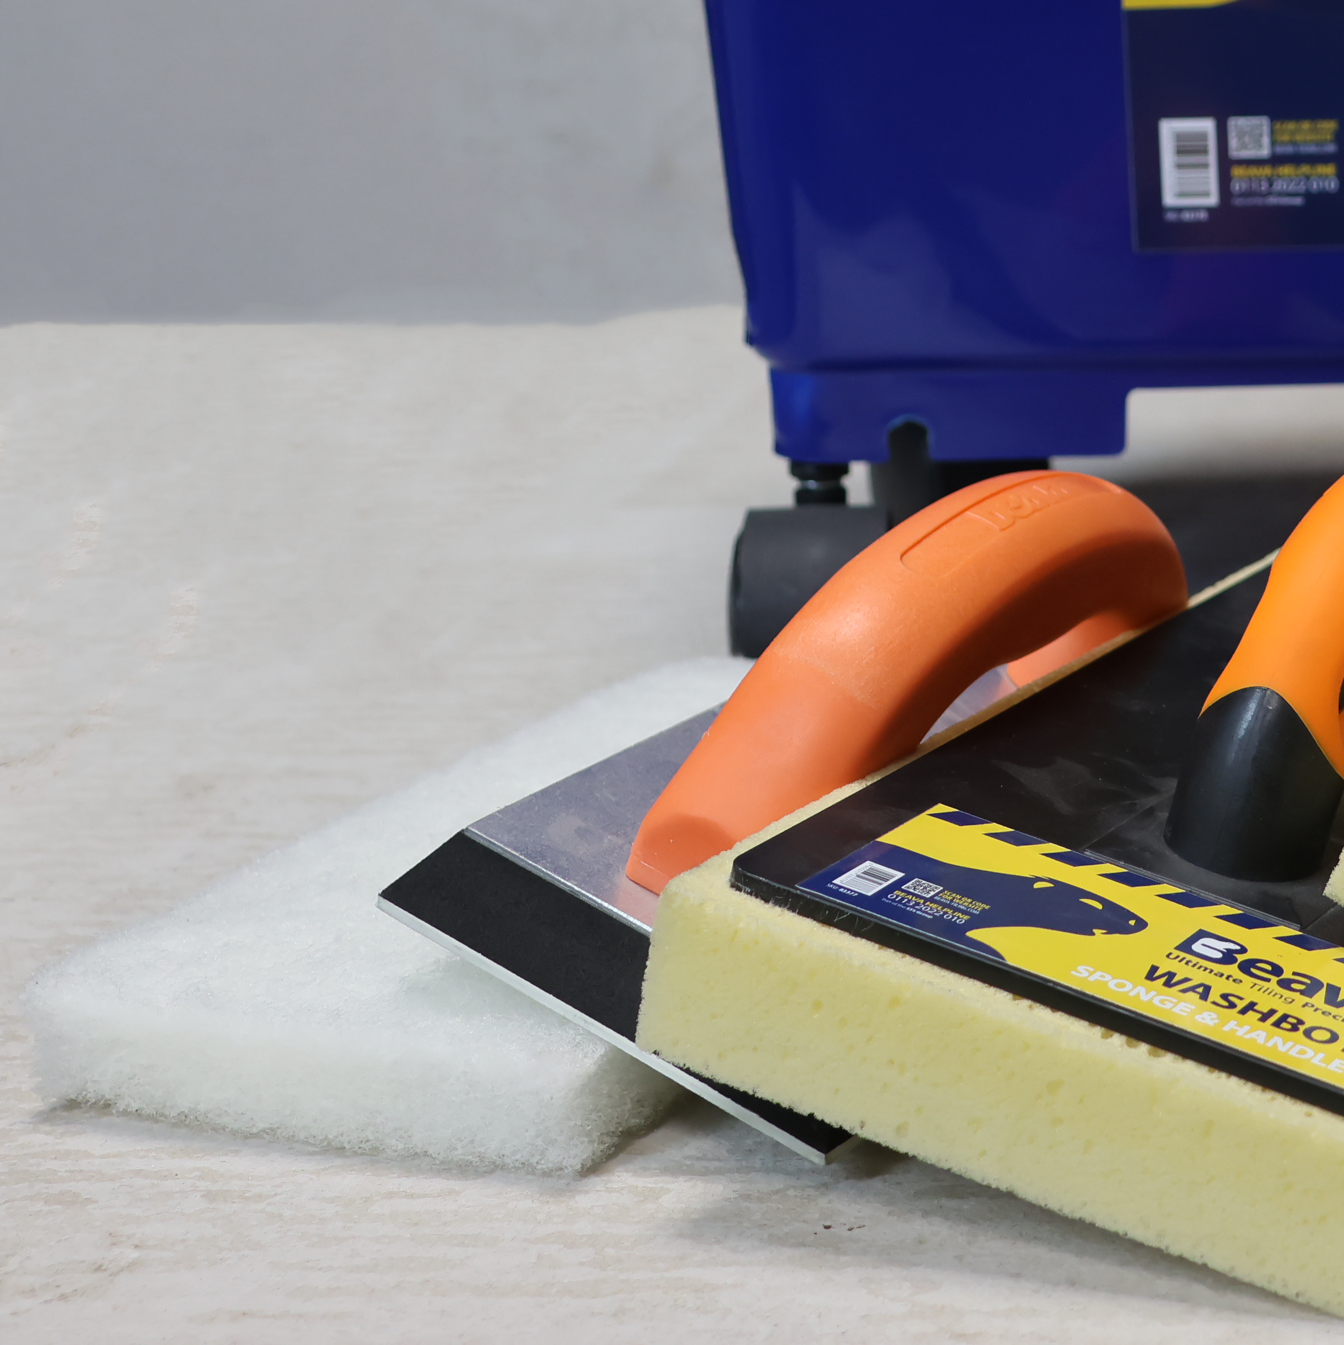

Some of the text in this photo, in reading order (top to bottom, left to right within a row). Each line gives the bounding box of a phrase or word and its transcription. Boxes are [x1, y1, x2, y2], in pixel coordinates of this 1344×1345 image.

[887, 893, 966, 924] 0113 2022 010
[893, 889, 971, 921] BEAVA HELPLINE
[938, 892, 953, 901] FOR
[972, 900, 991, 910] CODE
[1166, 951, 1244, 986] Ultimate
[1250, 981, 1295, 1005] Tiling
[1070, 964, 1196, 1017] SPONGE
[1194, 1010, 1220, 1027] &
